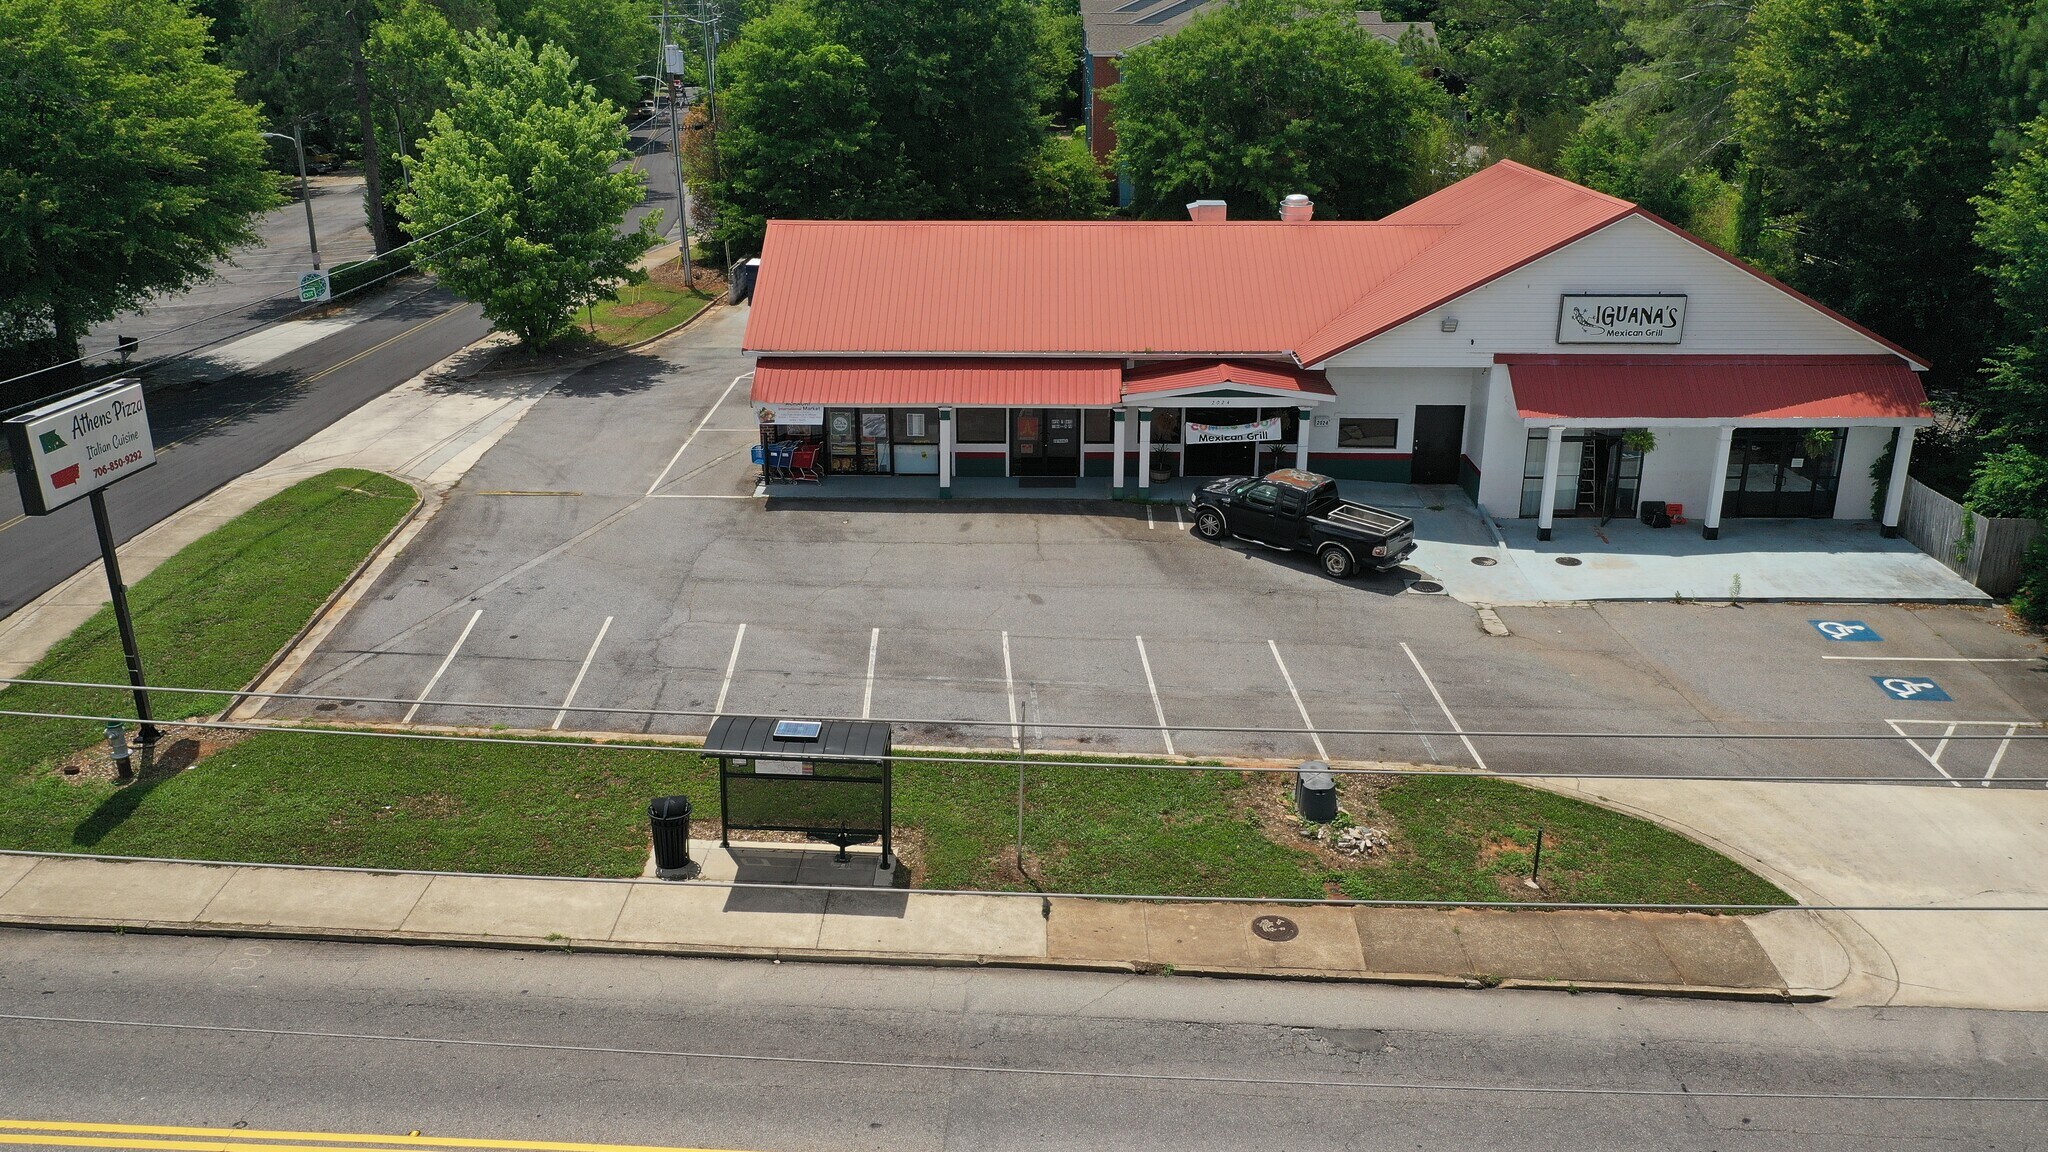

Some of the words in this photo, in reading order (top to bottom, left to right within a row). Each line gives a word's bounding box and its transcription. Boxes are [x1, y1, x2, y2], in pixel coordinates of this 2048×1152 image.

[1595, 305, 1678, 328] IGUANA'S
[1606, 329, 1643, 337] Mexican
[1645, 328, 1663, 337] Grill
[71, 410, 112, 440] Athens
[111, 399, 143, 421] Pizza
[86, 442, 111, 460] Italian
[112, 430, 139, 449] Cuisine
[1198, 434, 1243, 442] Mexican
[1246, 431, 1268, 440] Grill
[93, 450, 142, 478] 706-850-9292
